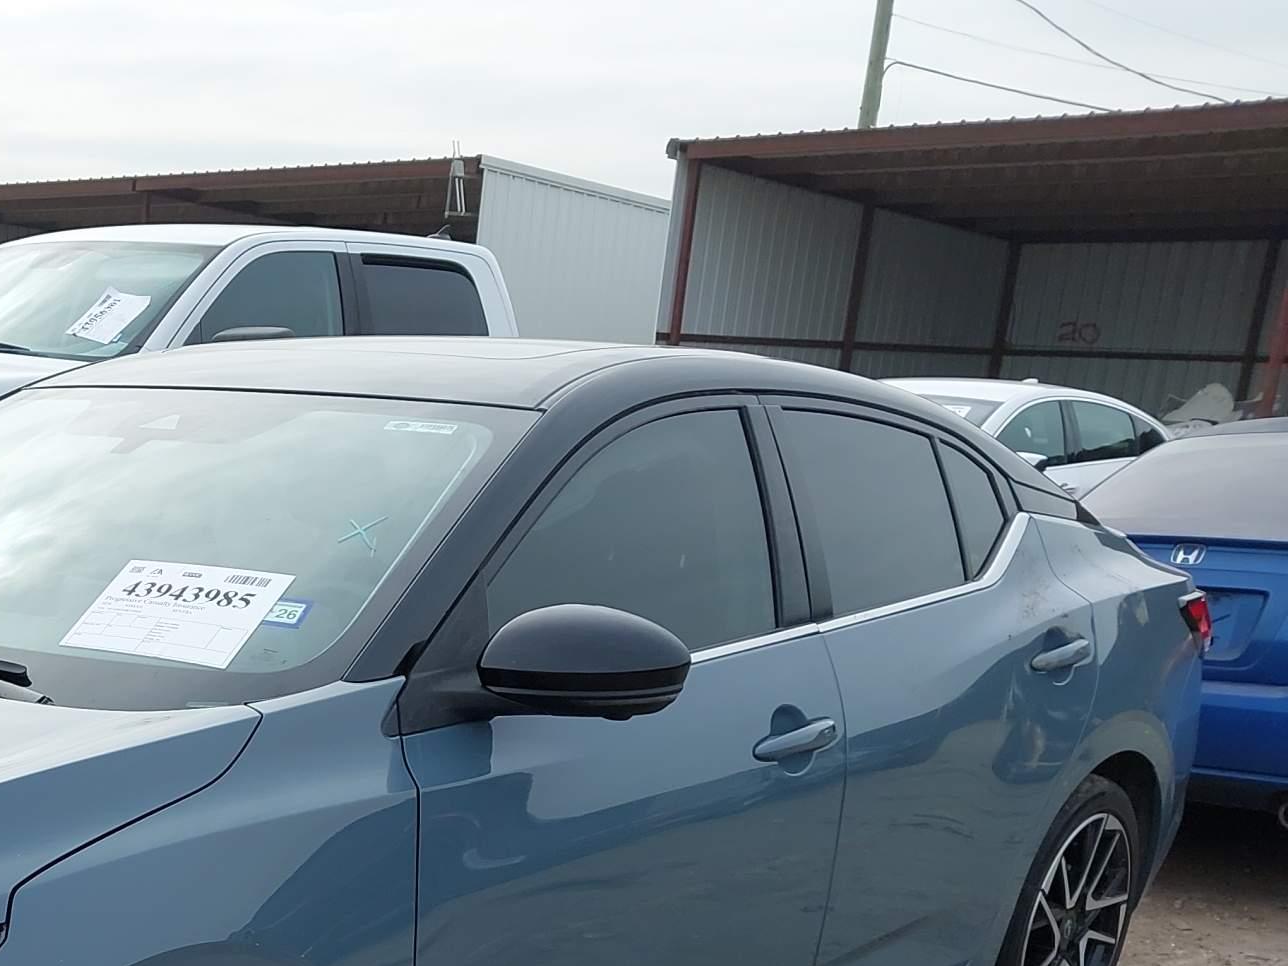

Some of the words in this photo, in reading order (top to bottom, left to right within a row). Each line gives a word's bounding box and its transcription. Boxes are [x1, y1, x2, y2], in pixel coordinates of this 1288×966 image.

[1057, 321, 1100, 345] 20
[122, 580, 257, 609] 43943985
[275, 608, 299, 620] 26
